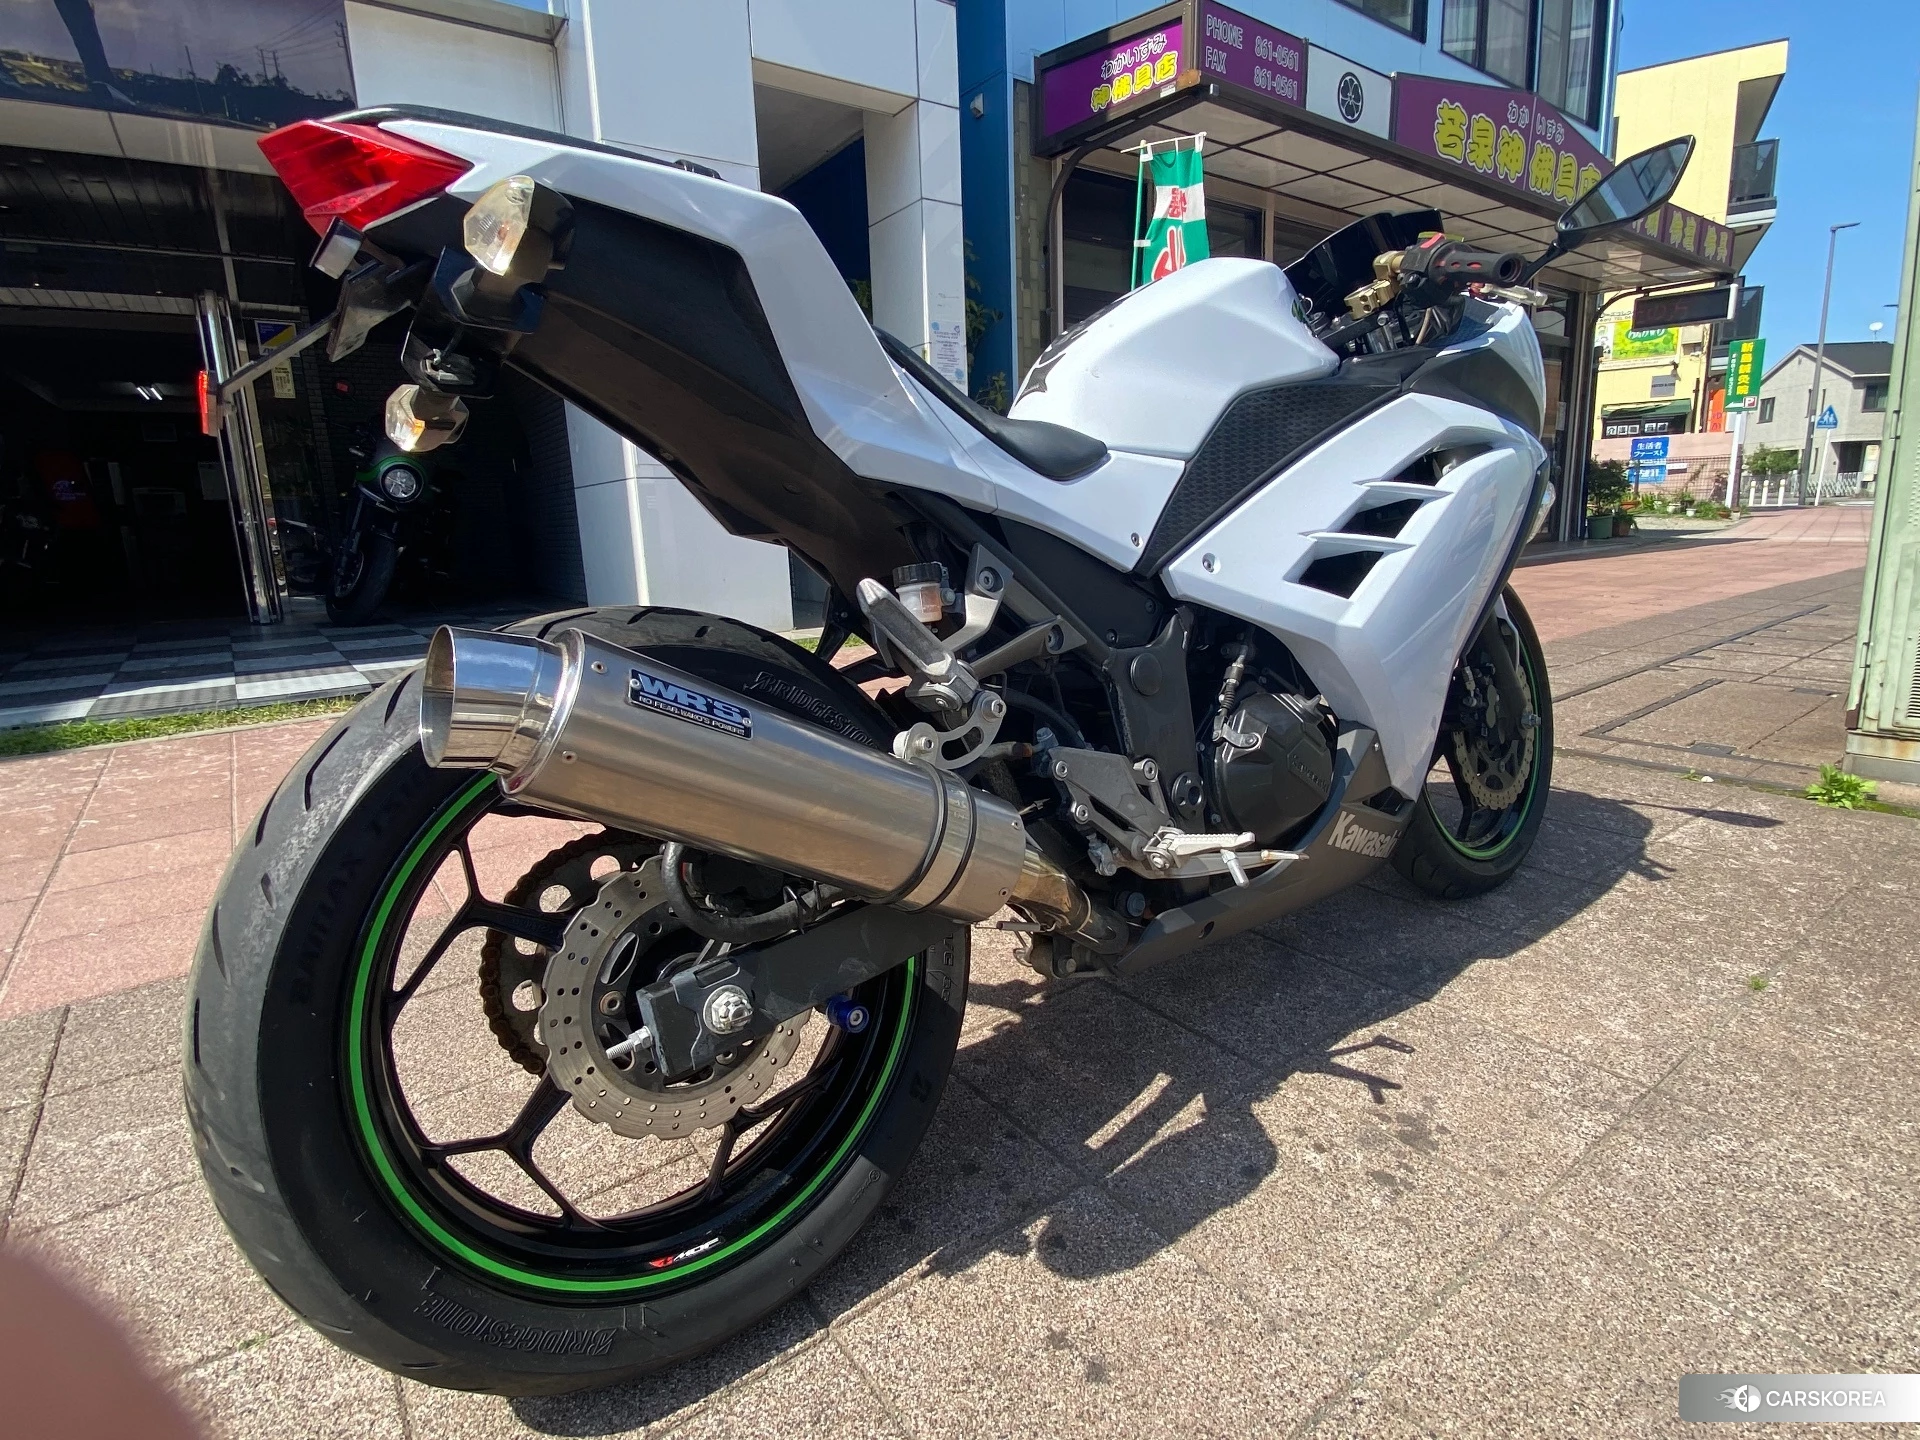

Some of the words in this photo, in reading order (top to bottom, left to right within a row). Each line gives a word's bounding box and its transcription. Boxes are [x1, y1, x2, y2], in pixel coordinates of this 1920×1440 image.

[1206, 14, 1243, 49] PHONE
[1254, 35, 1299, 72] 861-0561
[1205, 45, 1227, 74] FAX
[1253, 65, 1298, 101] 861-0561
[1634, 449, 1665, 458] ファースト
[1637, 441, 1663, 450] 生活者
[638, 673, 743, 724] WR'S
[639, 696, 653, 705] NO
[1327, 810, 1402, 858] Kawasaki
[413, 1291, 618, 1357] BRIDGESTONE
